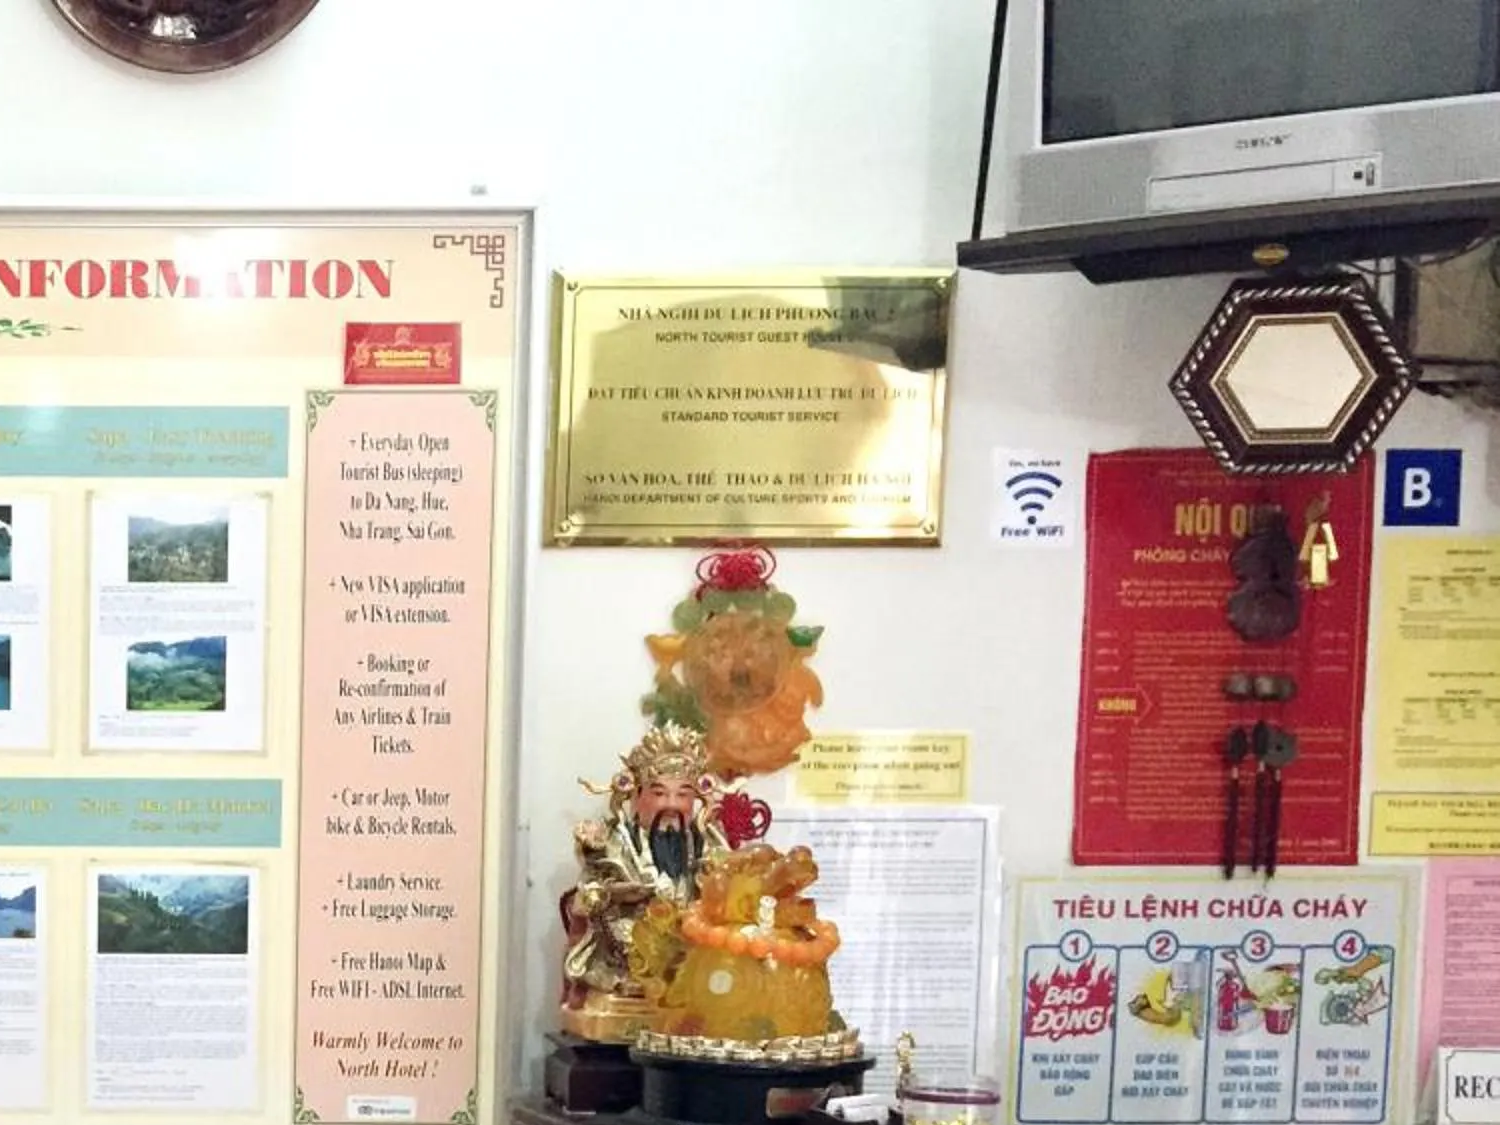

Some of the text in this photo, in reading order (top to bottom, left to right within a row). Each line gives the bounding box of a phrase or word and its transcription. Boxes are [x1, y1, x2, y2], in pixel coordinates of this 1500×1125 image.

[655, 331, 698, 343] NORTH
[702, 331, 753, 343] TOURIST
[757, 331, 798, 343] GUEST
[707, 387, 741, 400] KINH
[745, 387, 794, 399] DOANH
[661, 411, 838, 423] STANDARD TOURIST SERVICE
[361, 431, 449, 457] Everyday Open
[340, 461, 464, 485] Tourist Bus (sleeping)
[350, 495, 363, 510] to
[365, 491, 381, 510] Da
[623, 494, 701, 504] DEPARTMENT
[705, 494, 719, 504] OF
[724, 494, 776, 504] CULTURE
[782, 494, 828, 503] SPORTS
[340, 520, 363, 539] Nha
[406, 520, 425, 539] Sai
[1175, 497, 1222, 543] NỘI
[1001, 527, 1030, 537] Free
[341, 575, 465, 598] New VISA application
[345, 609, 358, 623] or
[361, 603, 393, 623] VISA
[366, 653, 431, 675] Booking or
[339, 678, 447, 697] Re-confirmation of
[334, 706, 451, 727] Any Airlines & Train
[341, 786, 364, 806] Car
[366, 793, 379, 806] or
[415, 787, 450, 806] Motor
[325, 816, 351, 835] bike
[353, 816, 364, 835] &
[367, 815, 409, 839] Bicycle
[347, 871, 395, 895] Laundry
[332, 898, 358, 917] Free
[361, 898, 409, 922] Luggage
[1123, 894, 1199, 922] LỆNH
[1293, 893, 1368, 918] CHÁY
[1067, 937, 1080, 955] 1
[1155, 937, 1170, 955] 2
[1251, 937, 1266, 955] 3
[1341, 937, 1356, 955] 4
[341, 951, 447, 976] Free Hanoi Map &
[311, 979, 335, 999] Free
[338, 979, 369, 999] WIFI
[381, 979, 416, 999] ADSL
[312, 1030, 463, 1055] Warmly Welcome to
[338, 1058, 379, 1078] North
[385, 1059, 428, 1079] Hotel
